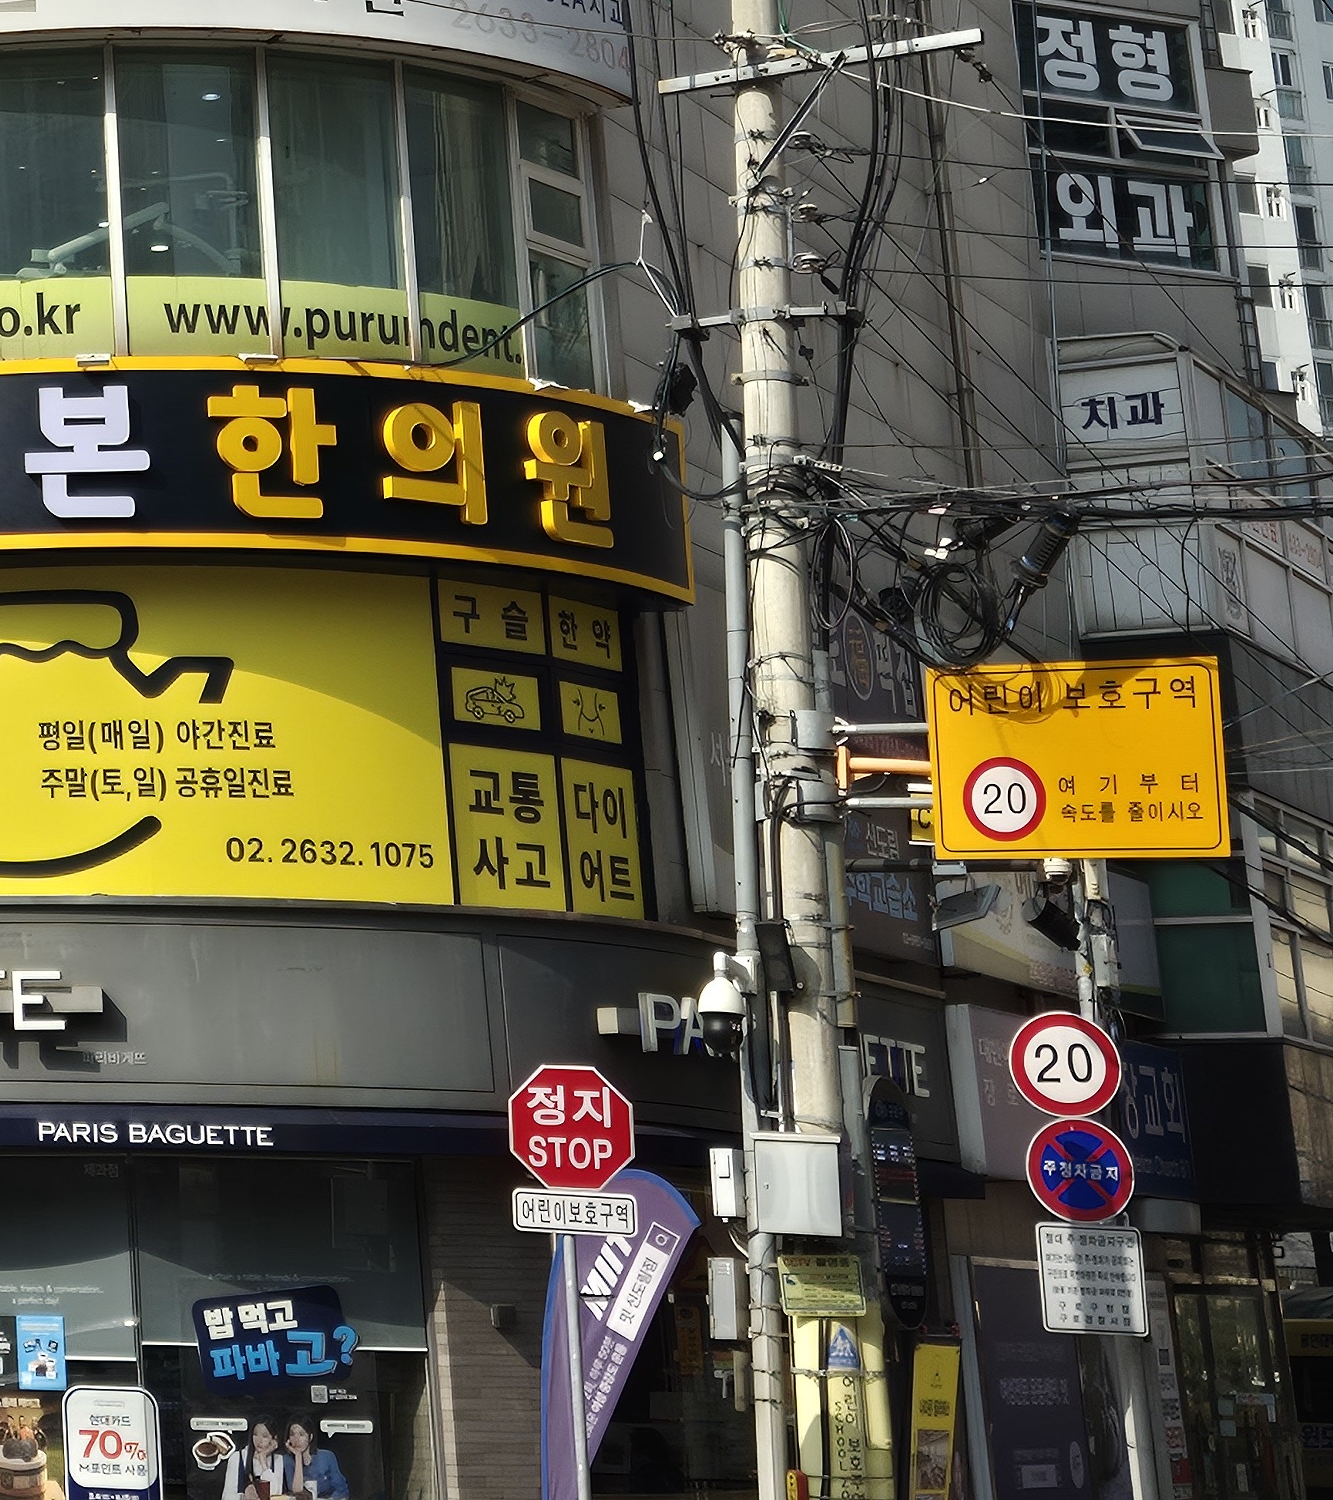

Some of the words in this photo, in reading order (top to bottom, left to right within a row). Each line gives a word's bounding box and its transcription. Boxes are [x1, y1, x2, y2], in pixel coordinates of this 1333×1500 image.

[1035, 17, 1173, 102] 정형
[1057, 172, 1194, 258] 외과
[1081, 390, 1165, 430] 치과
[948, 683, 1044, 716] 어린이
[1065, 675, 1197, 709] 보호구역
[39, 716, 163, 753] 평일(매일)
[176, 719, 276, 751] 야간진료
[39, 766, 167, 802] 주말(토,일)
[175, 766, 294, 800] 공휴일진료
[468, 769, 546, 826] 교통
[982, 783, 1028, 815] 20
[575, 785, 628, 838] 다이
[1127, 802, 1205, 824] 줄이시오
[470, 835, 550, 893] 사고
[578, 851, 635, 905] 어트
[1033, 1043, 1094, 1084] 20
[526, 1085, 613, 1129] 정지
[38, 1121, 118, 1144] PARIS
[129, 1124, 274, 1147] BAGUETTE
[528, 1135, 612, 1171] STOP
[521, 1197, 631, 1227] 어린이보호구역
[204, 1308, 234, 1334] 밥
[236, 1300, 299, 1334] 먹고
[79, 1429, 147, 1461] 70%
